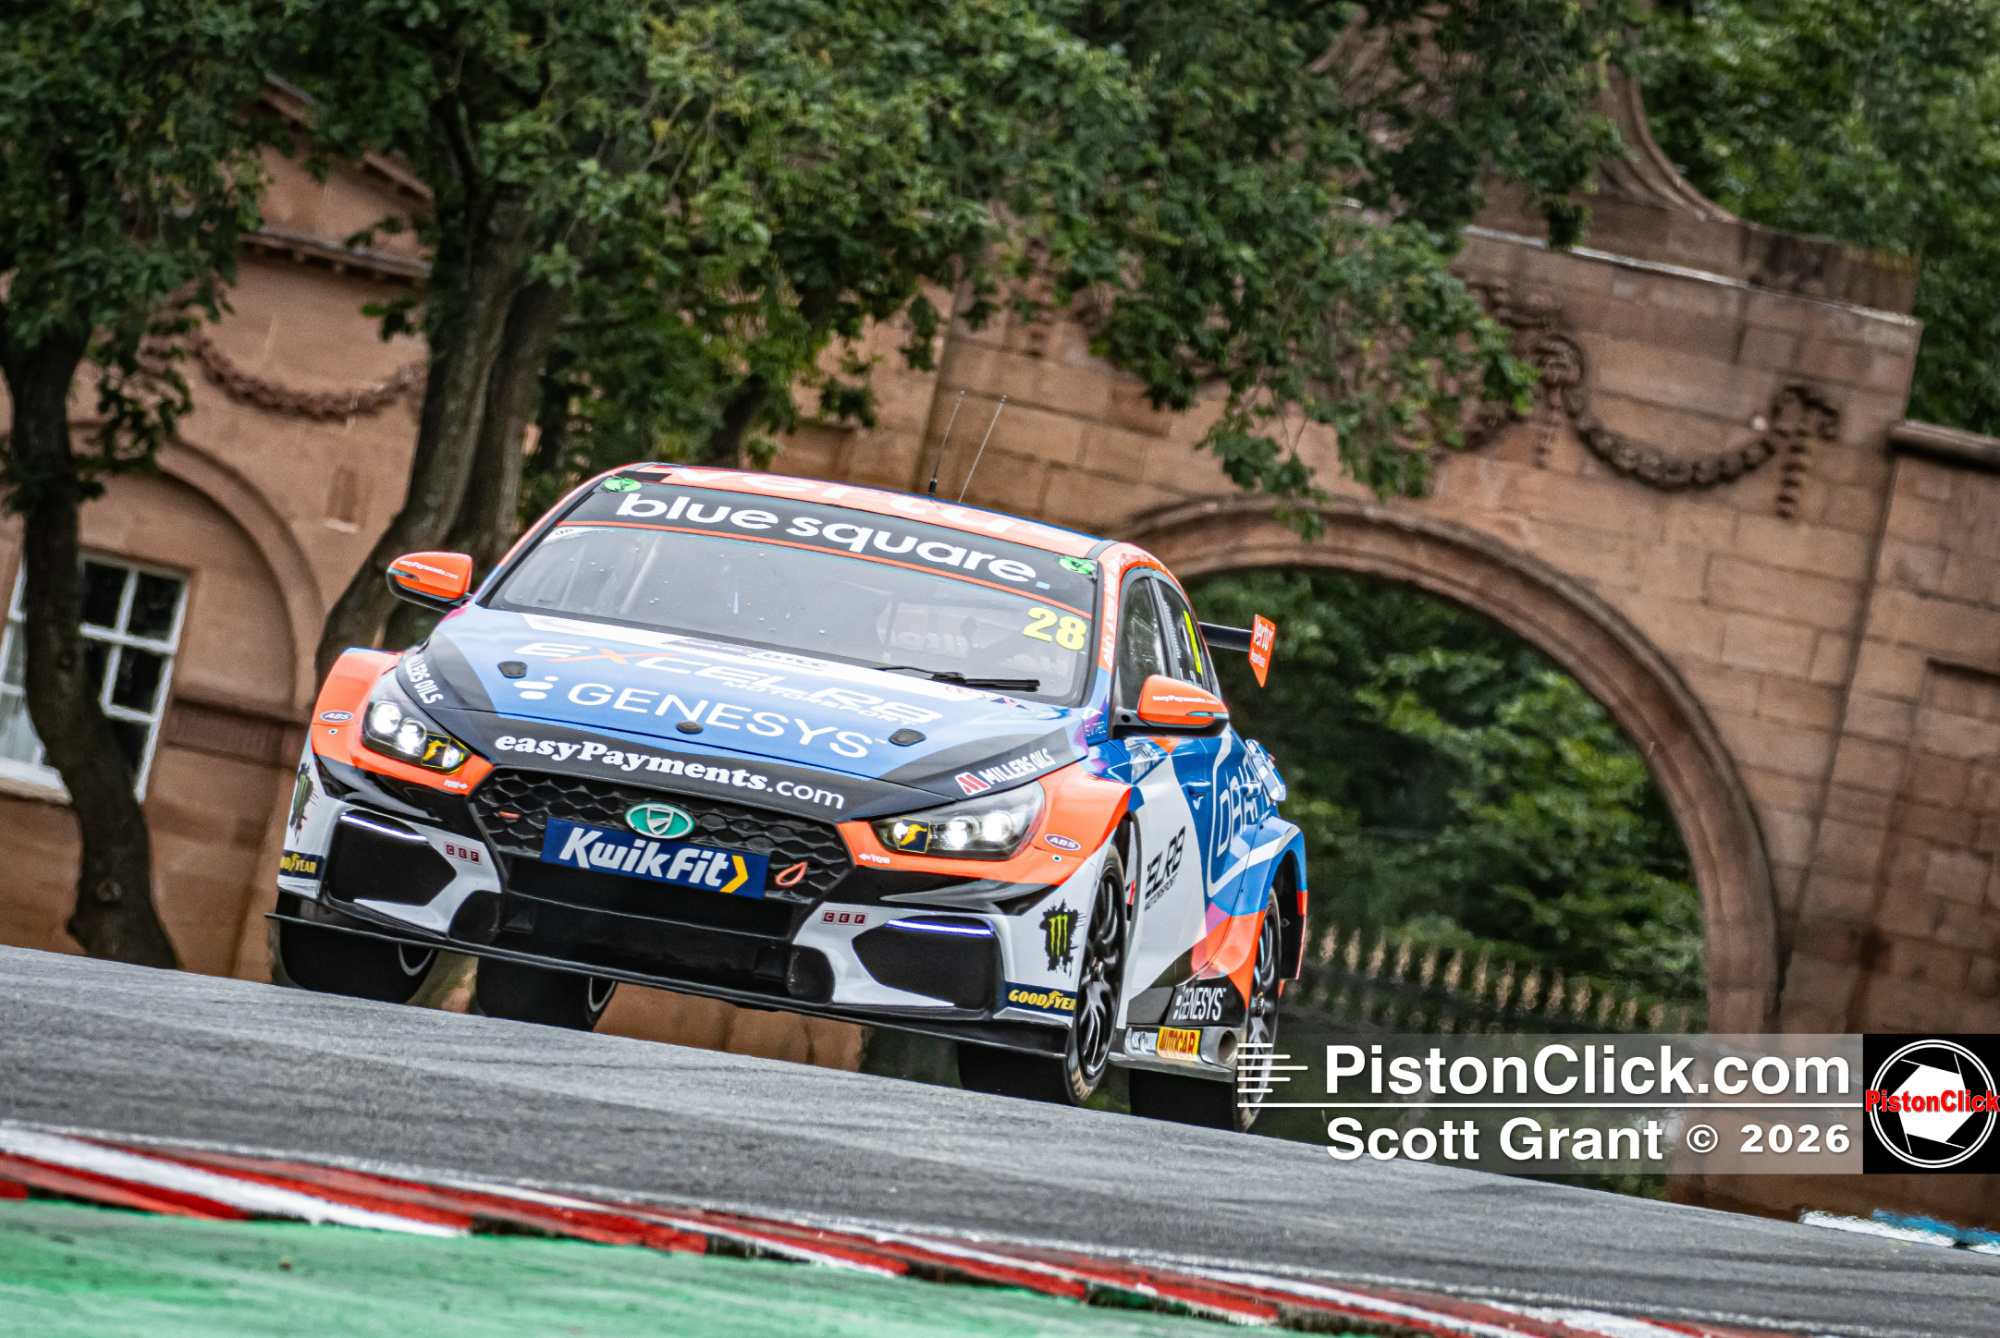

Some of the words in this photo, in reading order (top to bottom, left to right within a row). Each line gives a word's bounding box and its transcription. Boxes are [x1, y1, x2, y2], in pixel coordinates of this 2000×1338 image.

[615, 493, 779, 529] blue
[1022, 606, 1088, 651] 28
[514, 642, 943, 724] EXCELR8
[722, 681, 918, 726] MOTORSPORT
[567, 682, 873, 759] GENESYS
[494, 734, 845, 810] easyPayments.com
[978, 756, 1038, 785] MILLERS
[1030, 748, 1056, 769] OILS
[1049, 836, 1076, 848] ABS
[822, 911, 867, 925] CEF
